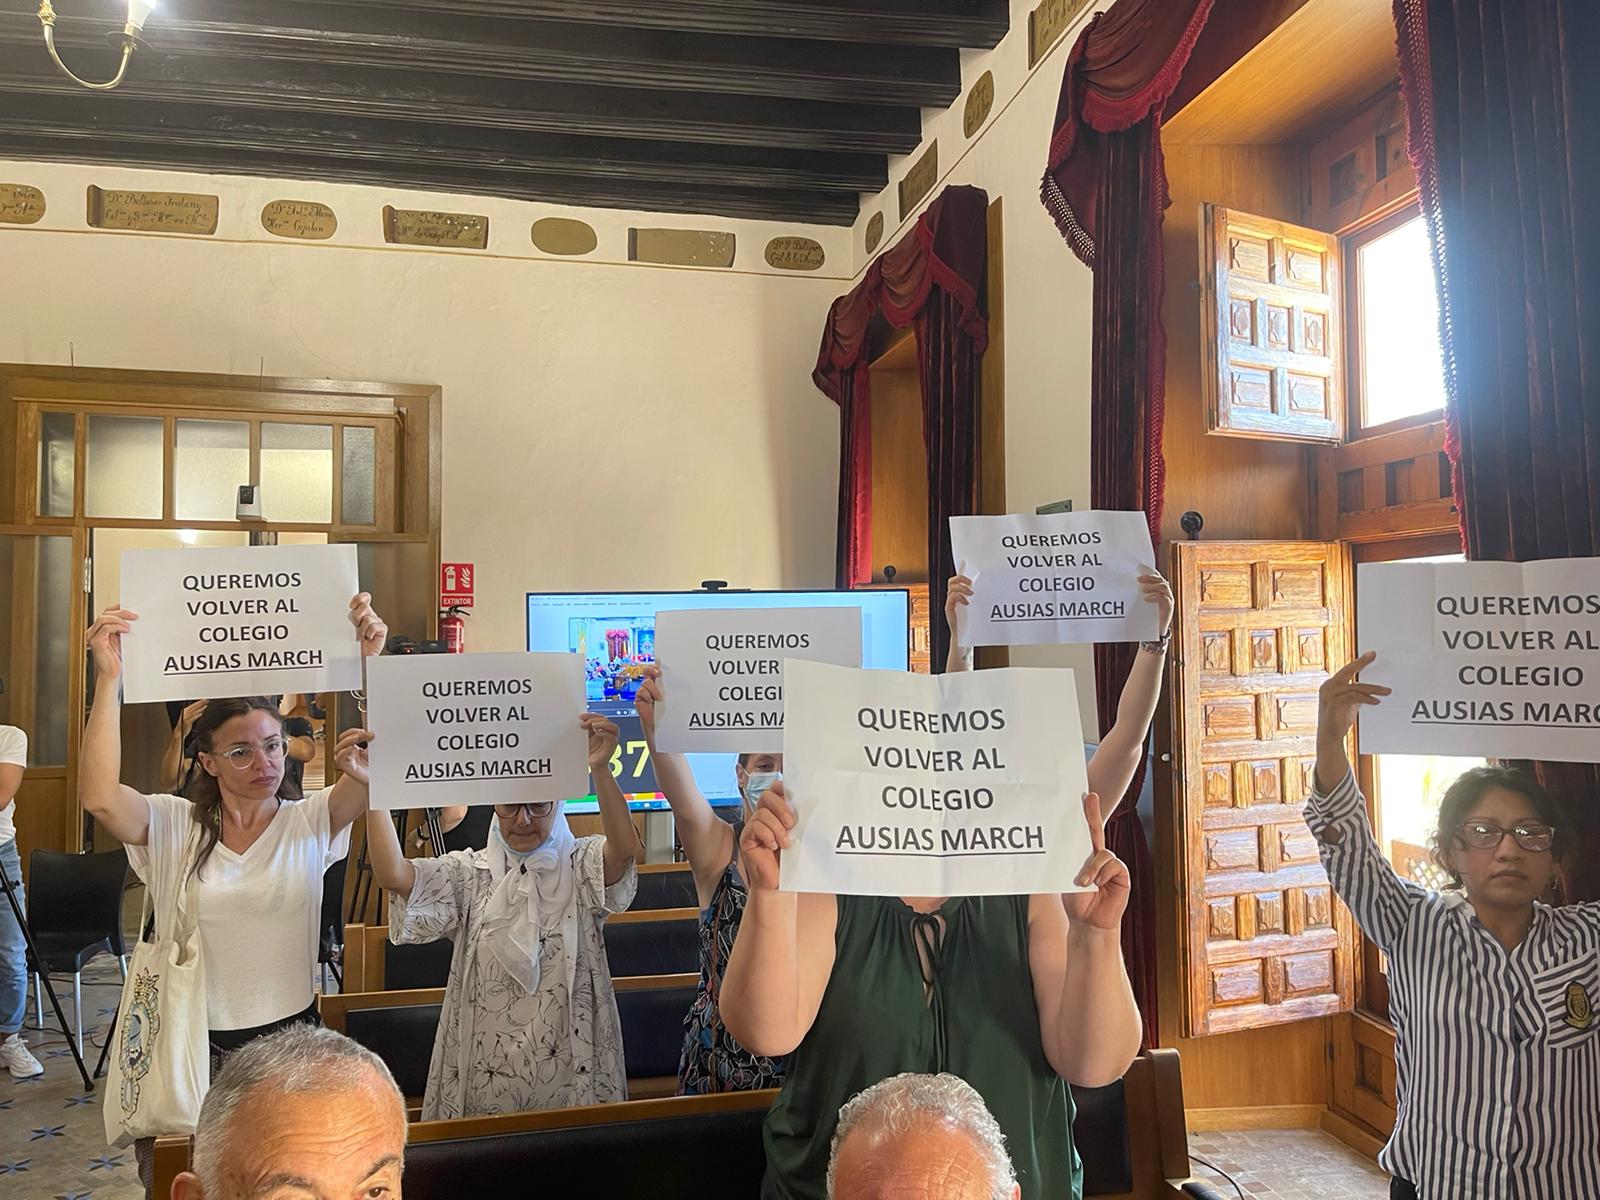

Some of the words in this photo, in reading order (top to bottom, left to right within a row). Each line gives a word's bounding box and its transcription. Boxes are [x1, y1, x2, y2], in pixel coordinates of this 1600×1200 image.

[1002, 532, 1101, 549] QUEREMOS
[1007, 555, 1076, 568] VOLVER
[1082, 554, 1102, 566] AL
[183, 573, 301, 592] QUEREMOS
[1019, 577, 1094, 592] COLEGIO
[187, 600, 268, 615] VOLVER
[275, 599, 299, 613] AL
[443, 597, 472, 605] EXTINTOR
[991, 603, 1055, 619] AUSIAS
[1060, 601, 1125, 617] MARCH
[1437, 595, 1600, 617] QUEREMOS
[200, 625, 288, 642] COLEGIO
[706, 634, 809, 651] QUEREMOS
[1443, 631, 1555, 650] VOLVER
[1565, 631, 1599, 649] AL
[164, 654, 242, 671] AUSIAS
[248, 650, 323, 667] MARCH
[709, 660, 779, 674] VOLVER
[1459, 666, 1583, 686] COLEGIO
[423, 679, 531, 699] QUEREMOS
[719, 686, 781, 701] COLEGI
[426, 707, 500, 723] VOLVER
[507, 706, 529, 721] AL
[689, 712, 754, 726] AUSIAS
[1412, 700, 1513, 721] AUSIAS
[858, 708, 1005, 734] QUEREMOS
[438, 733, 519, 750] COLEGIO
[864, 746, 963, 772] VOLVER
[972, 748, 1005, 770] AL
[406, 762, 475, 779] AUSIAS
[482, 758, 552, 776] MARCH
[882, 786, 993, 811] COLEGIO
[836, 826, 933, 850] AUSIAS
[941, 826, 1043, 851] MARCH
